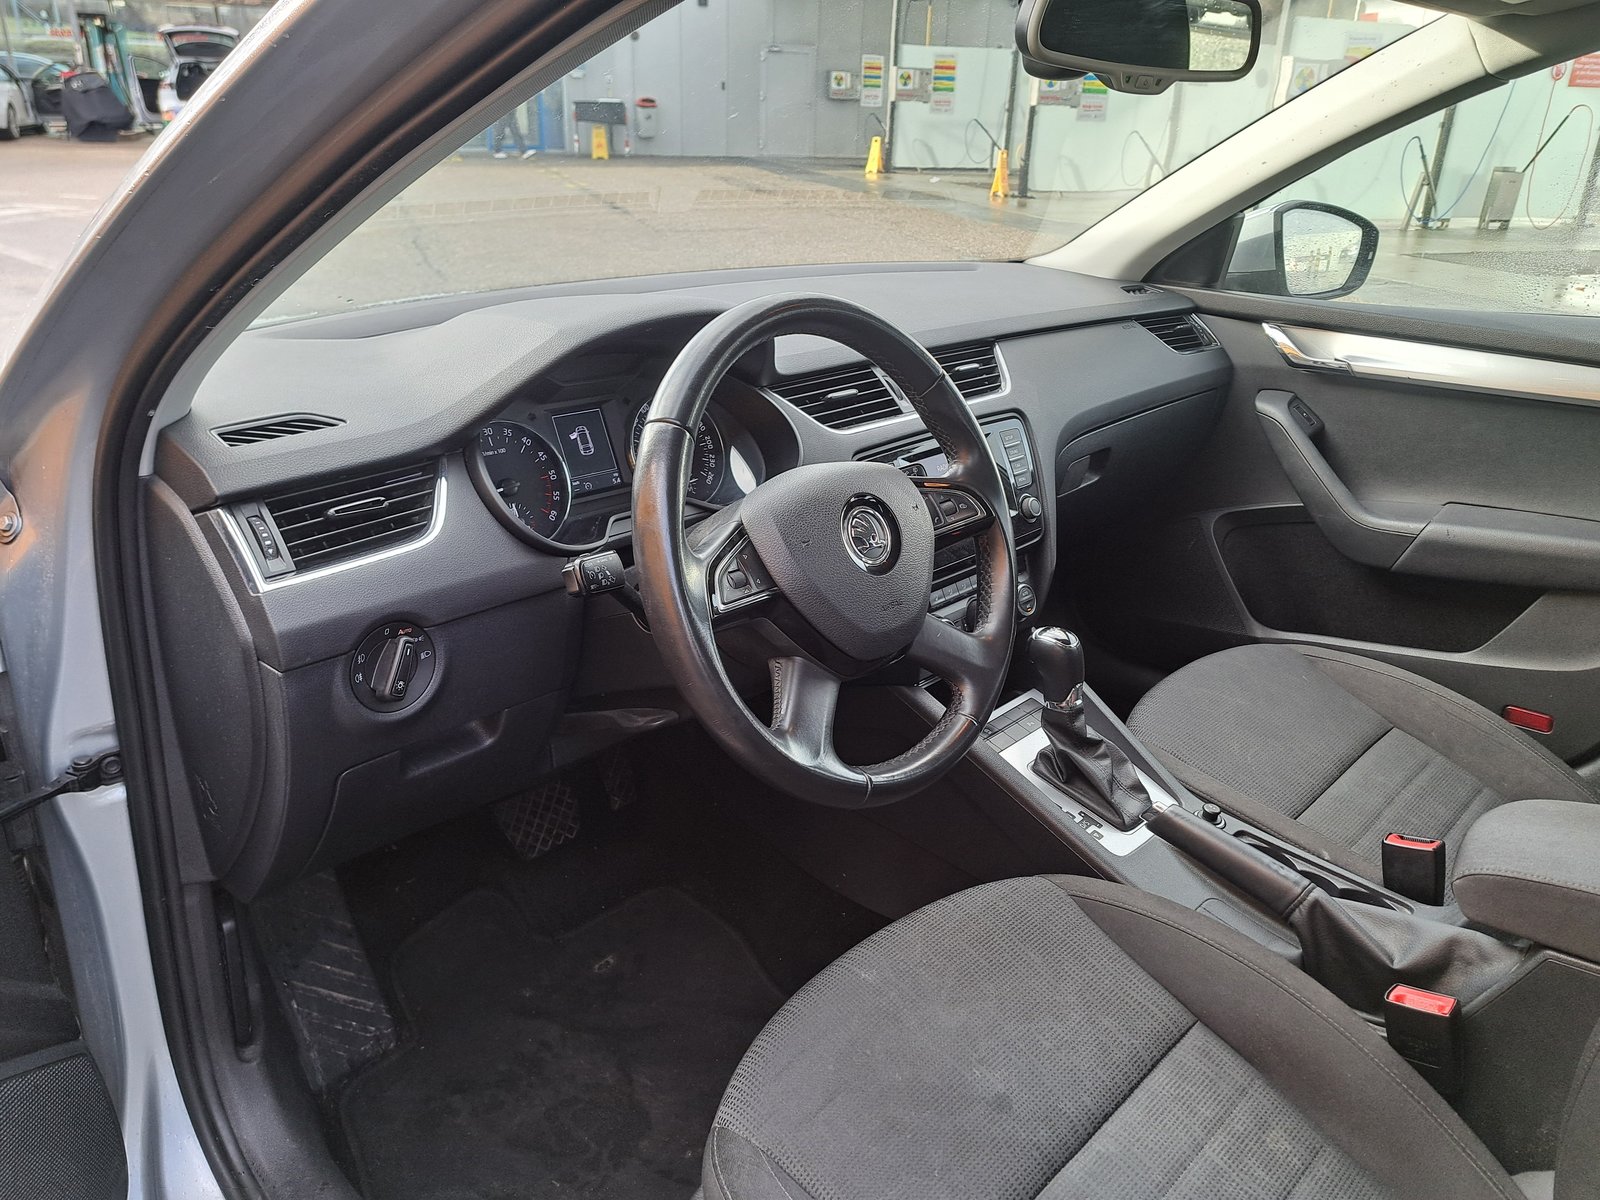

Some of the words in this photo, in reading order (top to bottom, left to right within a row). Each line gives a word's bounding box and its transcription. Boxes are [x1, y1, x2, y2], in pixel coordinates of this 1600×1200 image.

[482, 427, 493, 436] 30
[502, 427, 513, 437] 35
[521, 436, 532, 446] 40
[704, 435, 714, 450] 200
[537, 451, 548, 461] 45
[548, 470, 557, 480] 50
[706, 471, 715, 485] 260
[552, 490, 560, 501] 55
[548, 510, 558, 521] 60
